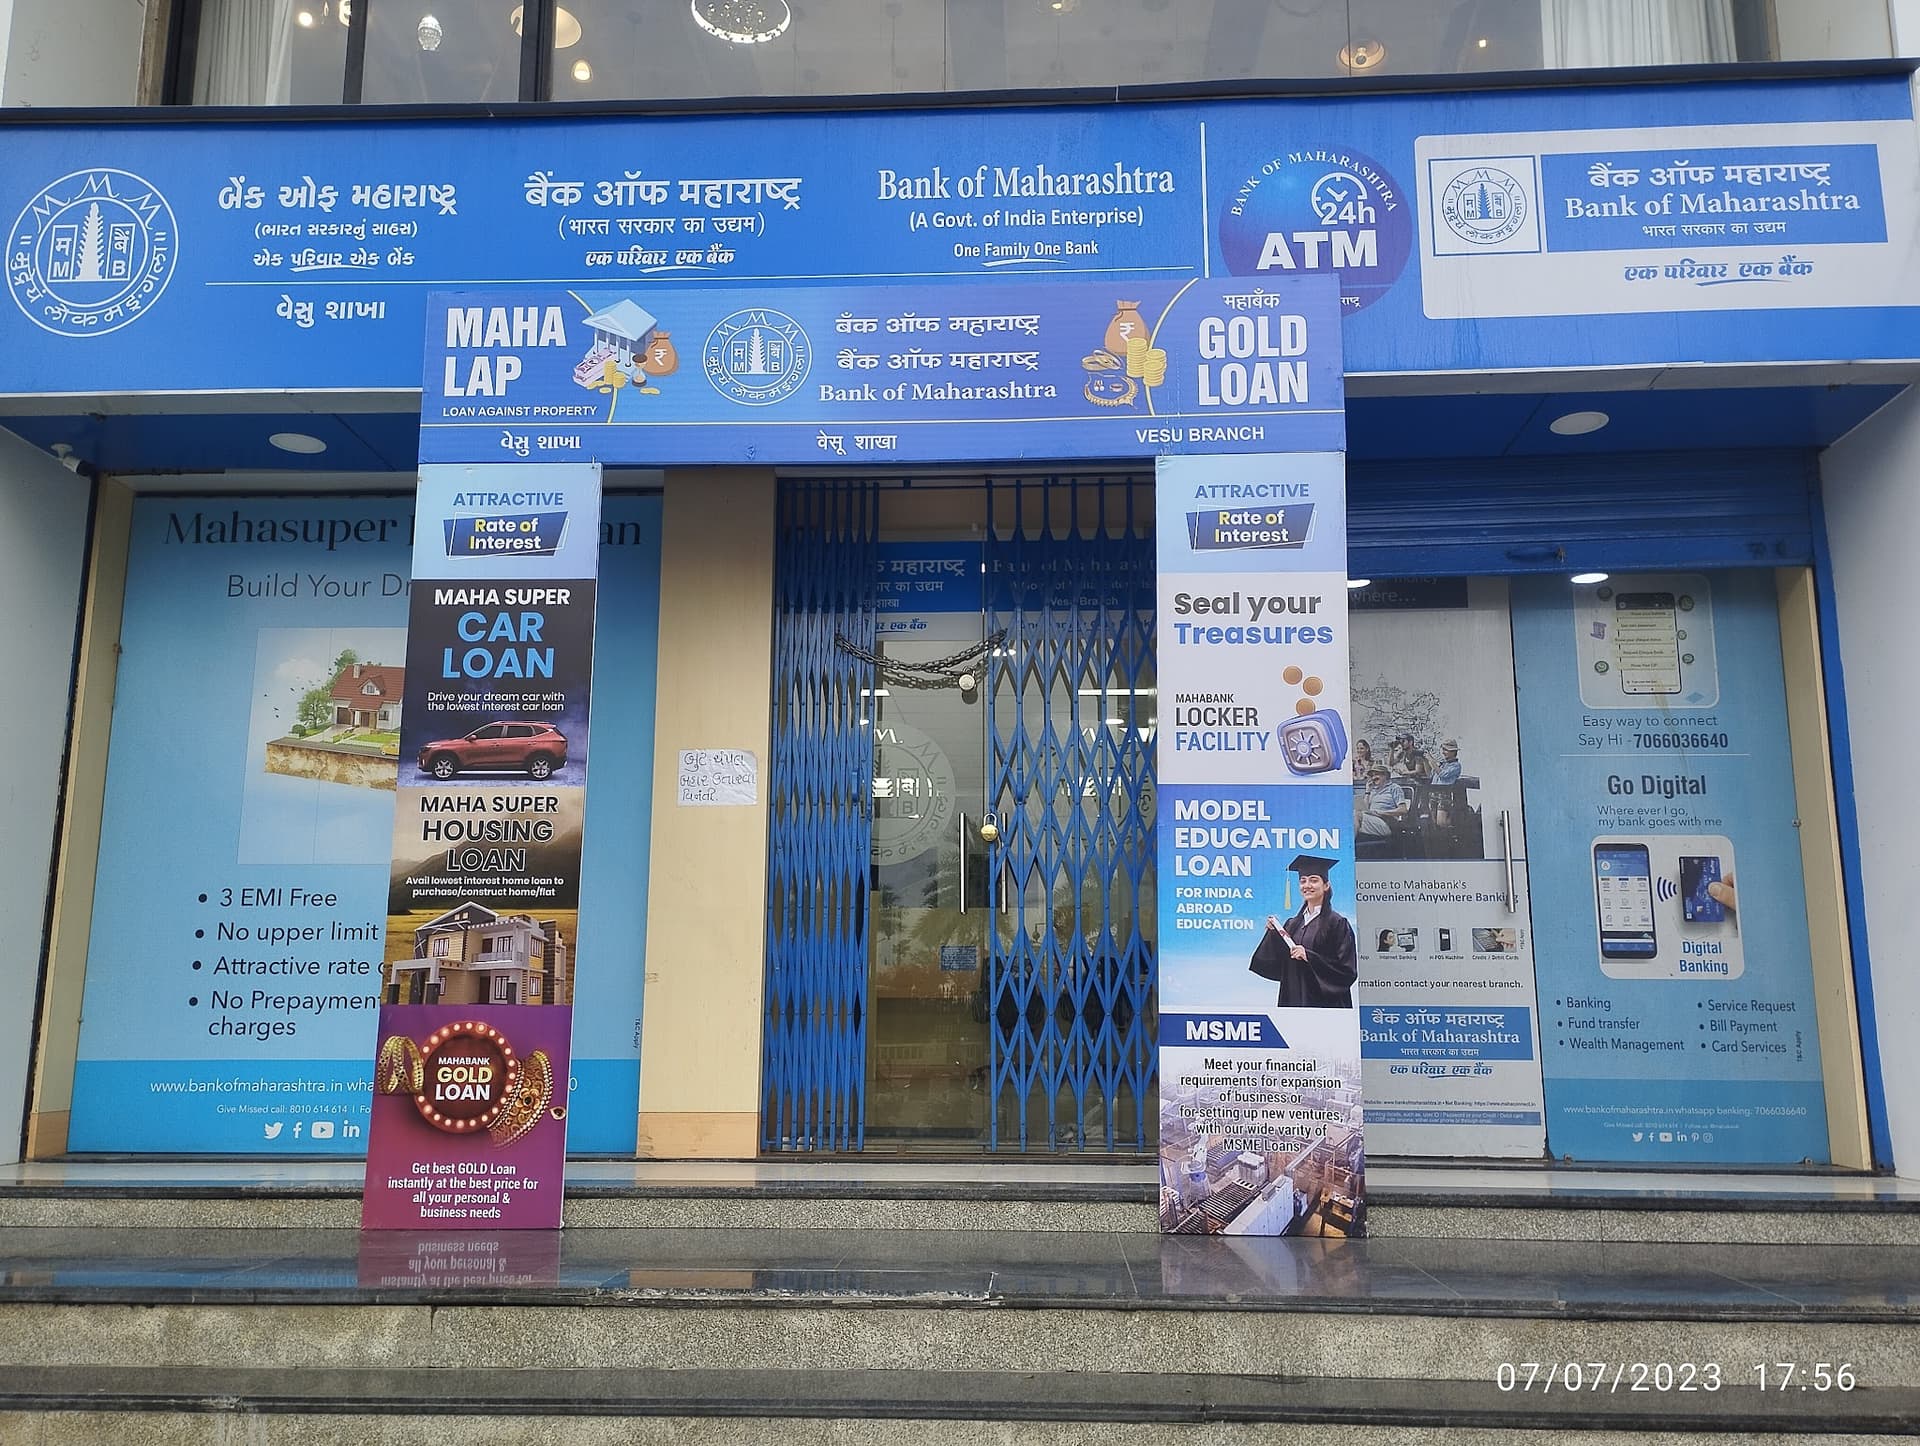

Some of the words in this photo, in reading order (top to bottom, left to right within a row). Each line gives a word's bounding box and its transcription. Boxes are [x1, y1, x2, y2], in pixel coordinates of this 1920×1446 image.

[877, 166, 951, 200] Bank
[956, 165, 988, 199] of
[993, 161, 1175, 198] Maharashtra
[1231, 175, 1261, 217] BANK
[1262, 158, 1282, 176] OF
[1288, 150, 1398, 212] MAHARASHTRA
[524, 170, 585, 207] बैंक
[593, 170, 671, 206] ऑफ
[678, 177, 802, 211] महाराष्ट्र
[1321, 201, 1376, 226] 24h
[1565, 195, 1639, 219] Bank
[1644, 193, 1673, 216] of
[1680, 189, 1861, 214] Maharashtra
[558, 214, 610, 240] (भारत
[616, 217, 675, 235] सरकार
[682, 217, 705, 233] का
[712, 211, 765, 237] उद्यम)
[909, 211, 928, 232] (A
[932, 211, 978, 229] Govt.
[982, 209, 1000, 227] of
[1004, 209, 1046, 227] India
[1051, 206, 1144, 226] Enterprise)
[953, 243, 980, 257] One
[984, 242, 1030, 260] Family
[1034, 241, 1061, 255] One
[1065, 239, 1099, 255] Bank
[1256, 229, 1378, 270] ATM
[446, 306, 567, 348] MAHA
[1198, 314, 1308, 360] GOLD
[443, 355, 522, 397] LAP
[1198, 361, 1309, 406] LOAN
[818, 384, 877, 402] Bank
[882, 383, 906, 401] of
[911, 381, 1057, 401] Maharashtra
[442, 407, 476, 417] LOAN
[478, 406, 530, 416] AGAINST
[533, 406, 597, 416] PROPERTY
[1136, 428, 1183, 443] VESU
[1189, 426, 1265, 442] BRANCH
[453, 492, 564, 506] ATTRACTIVE
[164, 511, 397, 551] Mahasuper
[474, 518, 517, 533] Rate
[519, 517, 539, 533] of
[469, 535, 542, 550] Interest
[890, 560, 966, 576] महाराष्ट्र
[227, 573, 298, 598] Build
[308, 573, 371, 597] Your
[434, 588, 500, 605] MAHA
[504, 588, 571, 605] SUPER
[1174, 592, 1240, 615] Seal
[1247, 596, 1322, 622] your
[457, 611, 545, 643] CAR
[1174, 623, 1333, 645] Treasures
[442, 647, 555, 679] LOAN
[427, 691, 455, 702] Drive
[456, 693, 481, 703] your
[483, 691, 520, 701] dream
[540, 691, 565, 701] with
[1175, 693, 1234, 703] MAHABANK
[1175, 707, 1259, 727] LOCKER
[1582, 715, 1612, 729] Easy
[1616, 718, 1642, 729] way
[1646, 716, 1659, 727] to
[1663, 716, 1718, 727] connect
[1175, 731, 1270, 751] FACILITY
[1578, 733, 1603, 749] Say
[1608, 733, 1623, 746] Hi
[1633, 733, 1728, 748] 7066036640
[1607, 775, 1634, 795] Go
[1641, 775, 1707, 799] Digital
[420, 796, 487, 813] MAHA
[492, 796, 559, 813] SUPER
[1175, 799, 1271, 821] MODEL
[422, 819, 554, 842] HOUSING
[1175, 827, 1340, 849] EDUCATION
[446, 848, 526, 872] LOAN
[1175, 855, 1252, 877] LOAN
[220, 888, 232, 907] 3
[241, 888, 282, 907] EMI
[290, 888, 337, 907] Free
[1418, 893, 1472, 903] Anywhere
[217, 922, 249, 941] No
[257, 927, 324, 946] upper
[330, 921, 379, 940] limit
[1682, 941, 1722, 955] Digital
[213, 956, 320, 975] Attractive
[328, 958, 370, 975] rate
[1679, 960, 1728, 975] Banking
[1394, 980, 1428, 988] contact
[1430, 981, 1451, 990] your
[1489, 980, 1523, 988] branch.
[211, 990, 243, 1009] No
[251, 990, 381, 1014] Prepaymen
[1566, 997, 1611, 1011] Banking
[1708, 1000, 1747, 1011] Service
[1751, 1000, 1796, 1013] Request
[208, 1016, 296, 1040] charges
[1186, 1021, 1262, 1041] MSME
[1568, 1018, 1596, 1029] Fund
[1599, 1018, 1640, 1029] transfer
[1710, 1020, 1727, 1031] Bill
[1730, 1020, 1777, 1035] Payment
[1402, 1028, 1418, 1043] of
[1421, 1029, 1520, 1043] Maharashtra
[1569, 1037, 1609, 1050] Wealth
[1611, 1038, 1684, 1053] Management
[1711, 1041, 1738, 1052] Card
[1741, 1041, 1787, 1053] Services
[438, 1057, 490, 1065] MAHABANK
[1204, 1058, 1233, 1070] Meet
[1236, 1061, 1262, 1073] your
[1266, 1059, 1317, 1072] financial
[150, 1078, 342, 1092] www.bankofmaharashtra.in
[437, 1067, 493, 1084] GOLD
[1180, 1075, 1258, 1089] requirements
[1261, 1074, 1278, 1087] for
[1281, 1076, 1341, 1089] expansion
[435, 1084, 490, 1101] LOAN
[217, 1105, 236, 1114] Give
[239, 1105, 269, 1114] Missed
[271, 1105, 288, 1114] call:
[290, 1105, 311, 1114] 8010
[313, 1105, 329, 1114] 614
[331, 1105, 347, 1114] 614
[1196, 1122, 1221, 1134] with
[1225, 1125, 1243, 1134] our
[1247, 1123, 1275, 1135] wide
[1277, 1124, 1311, 1137] varity
[1315, 1124, 1327, 1136] of
[412, 1162, 430, 1174] Get
[433, 1163, 455, 1174] best
[458, 1163, 488, 1174] GOLD
[490, 1163, 516, 1175] Loan
